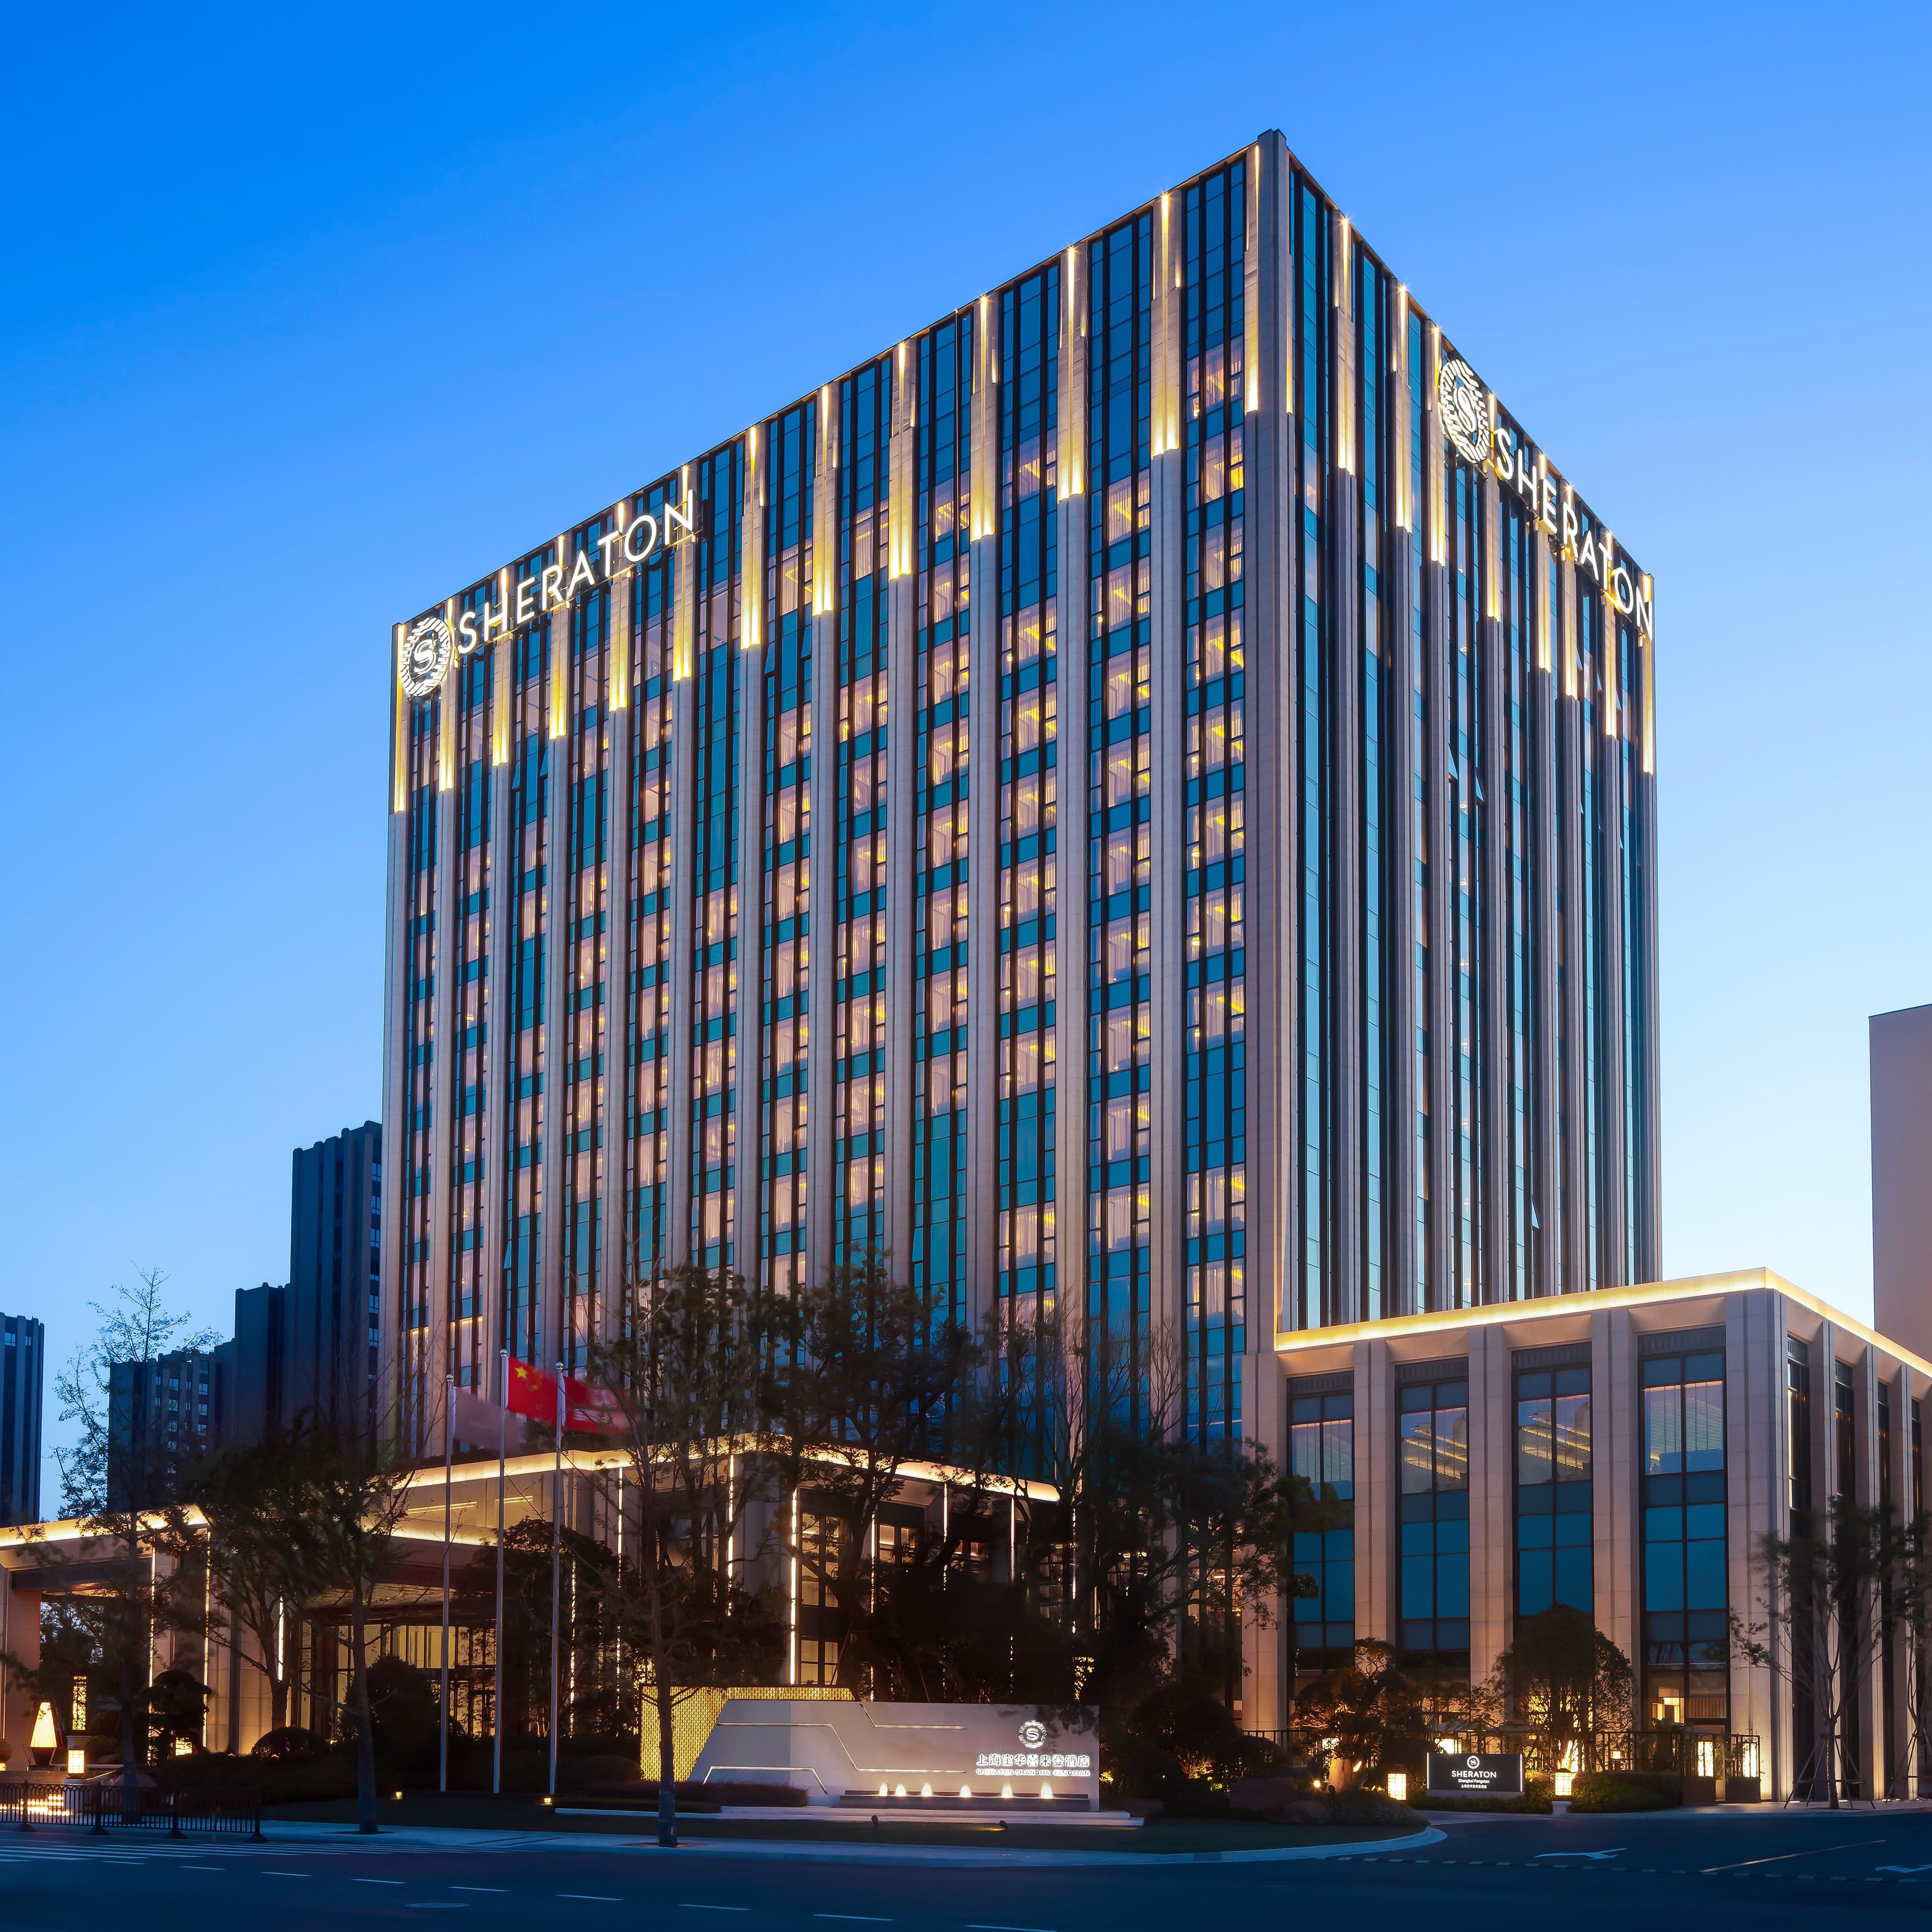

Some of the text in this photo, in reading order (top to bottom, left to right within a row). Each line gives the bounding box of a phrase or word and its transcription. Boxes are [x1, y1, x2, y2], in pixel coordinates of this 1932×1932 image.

[457, 490, 695, 654] SHERATON
[1495, 428, 1652, 642] SHERATON
[976, 1754, 1090, 1767] 上海宝华喜来登酒店
